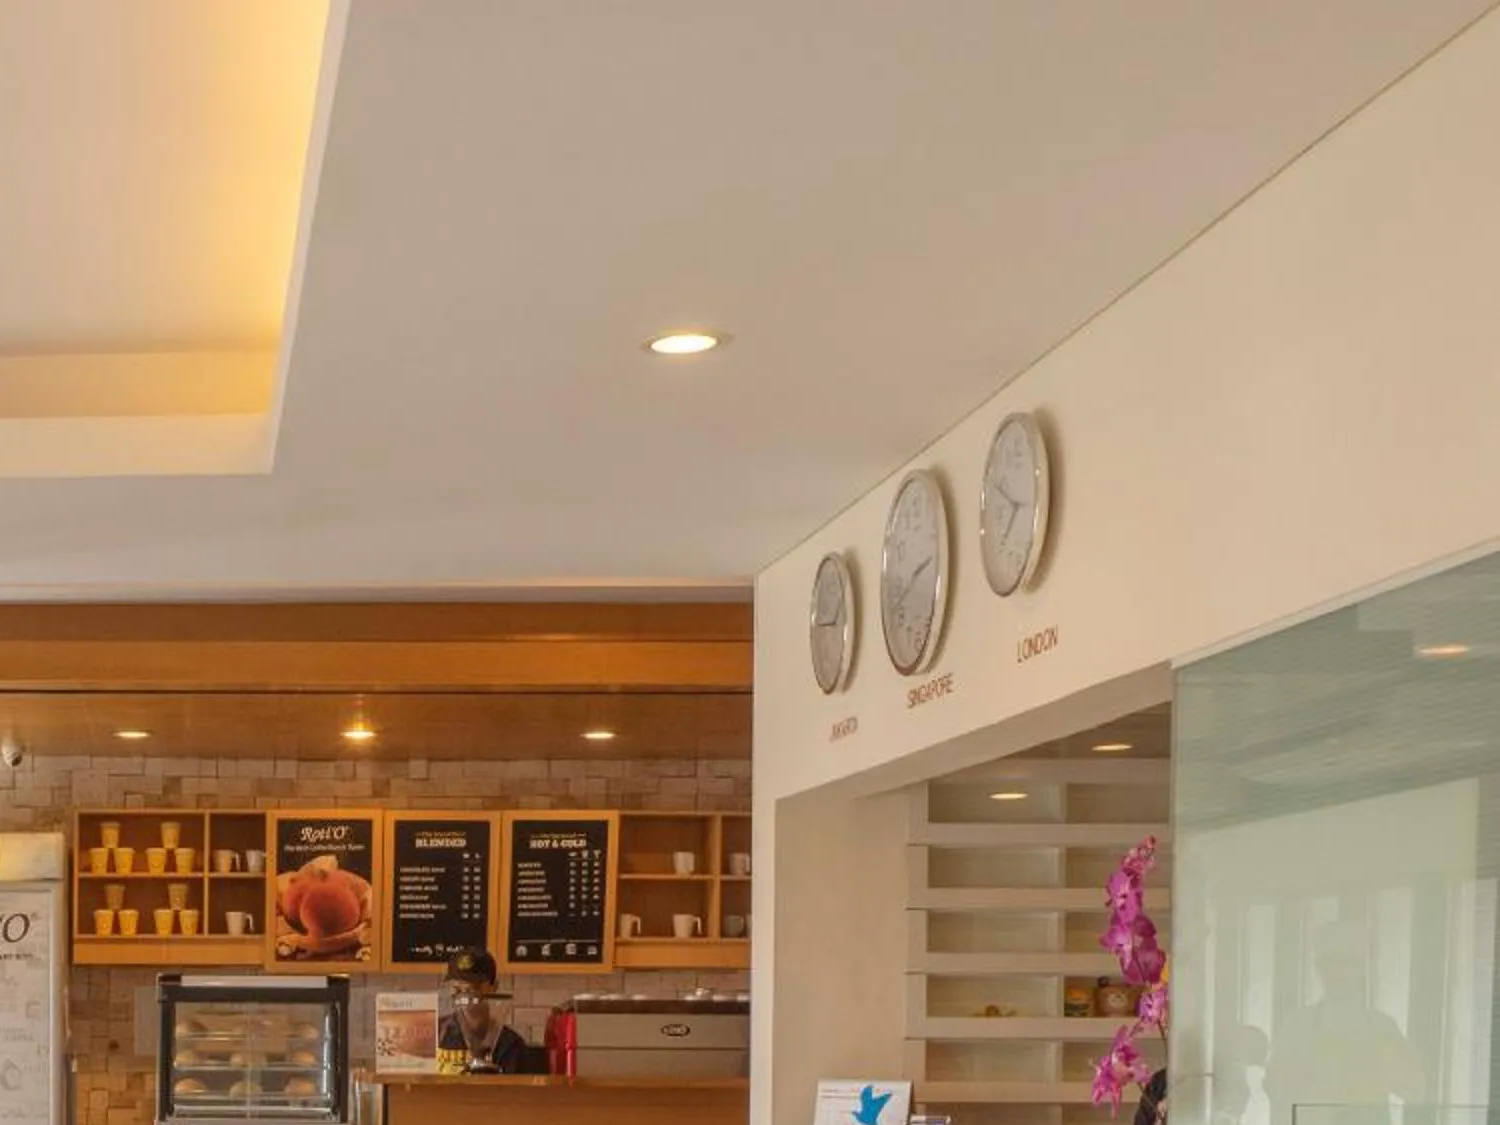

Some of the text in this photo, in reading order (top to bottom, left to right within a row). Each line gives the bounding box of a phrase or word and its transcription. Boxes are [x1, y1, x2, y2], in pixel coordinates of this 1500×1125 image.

[1016, 624, 1059, 664] LONDON
[907, 672, 954, 709] SINGAPORE
[415, 838, 467, 849] BLENDED
[530, 839, 550, 849] HOT
